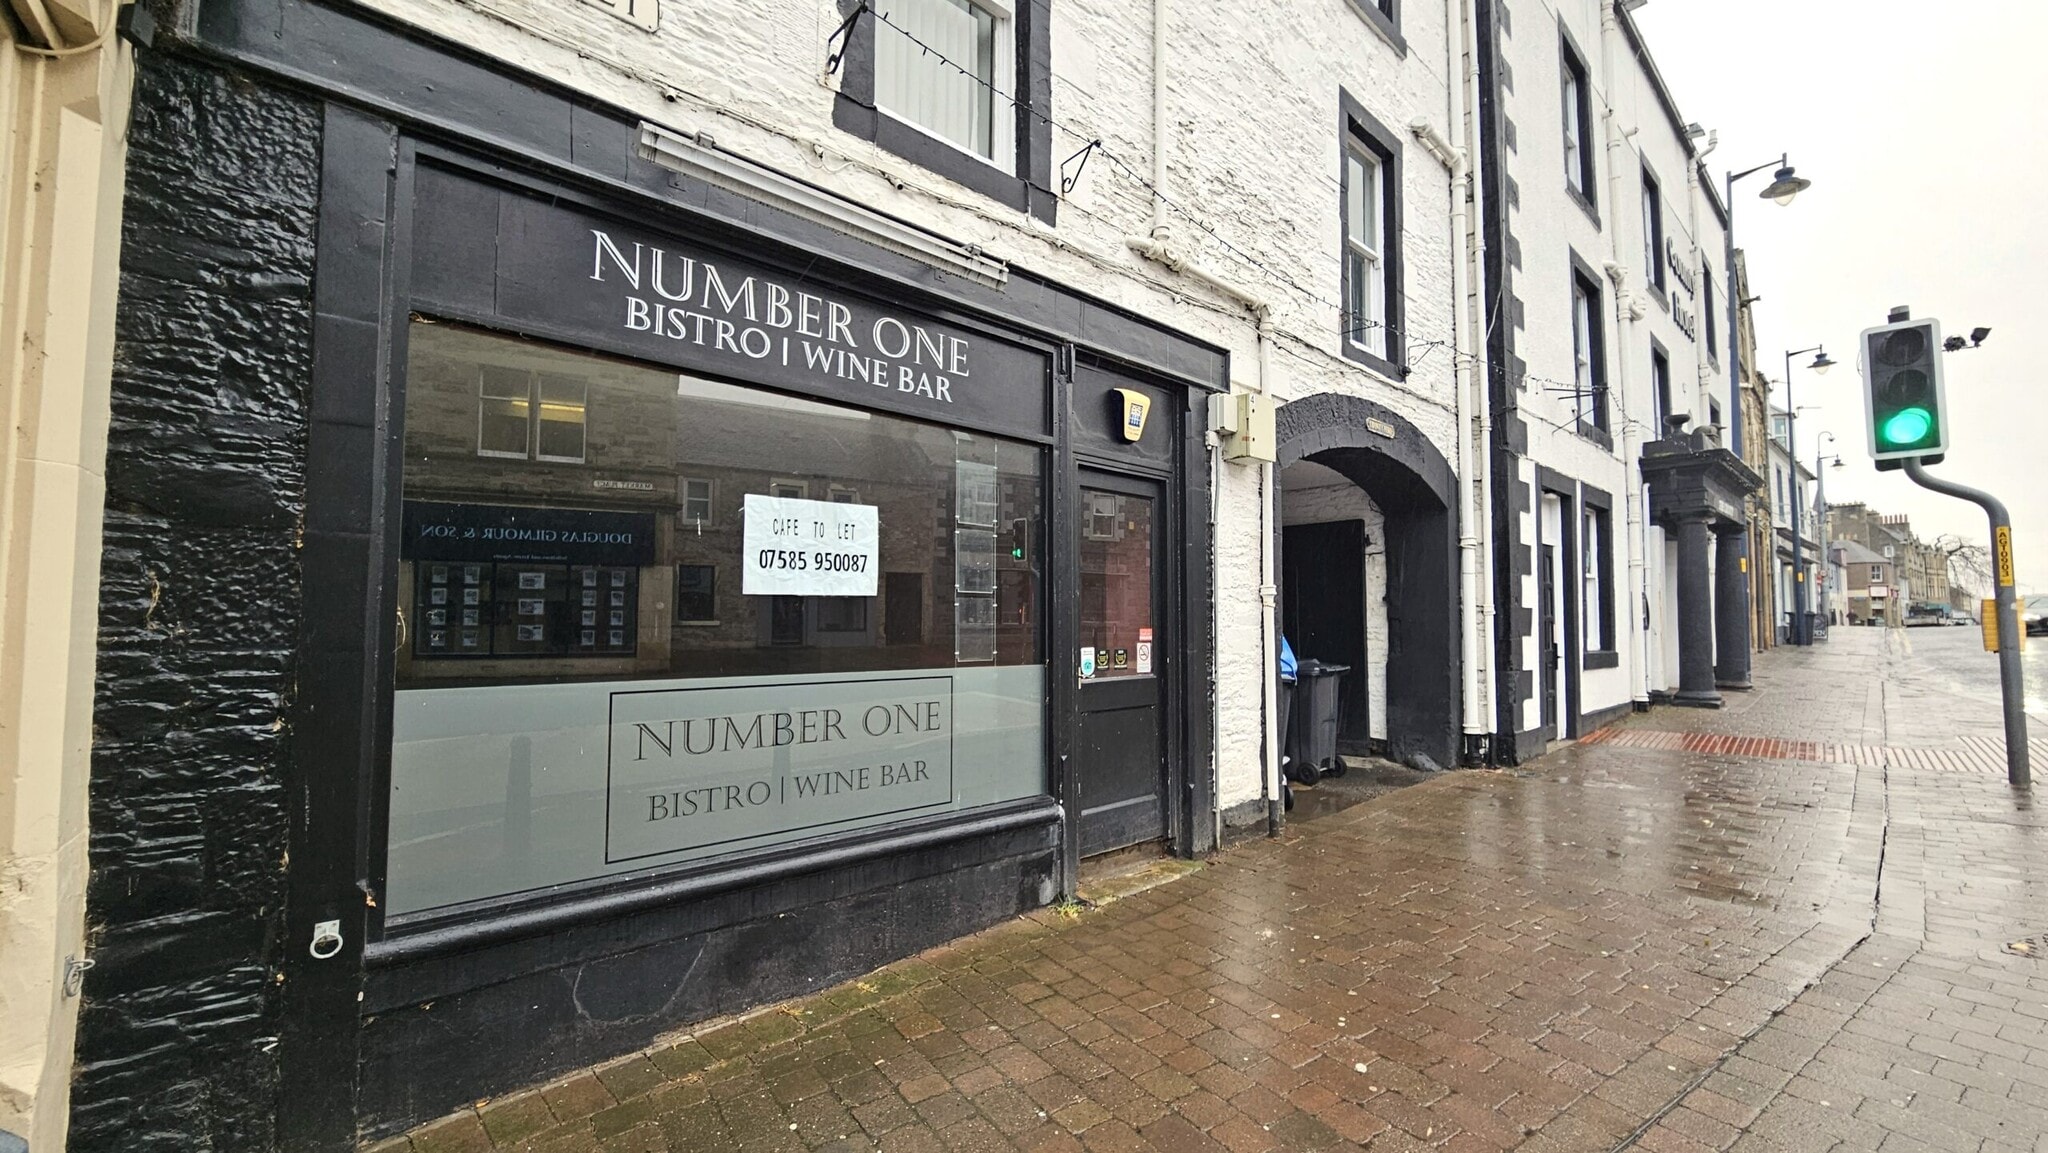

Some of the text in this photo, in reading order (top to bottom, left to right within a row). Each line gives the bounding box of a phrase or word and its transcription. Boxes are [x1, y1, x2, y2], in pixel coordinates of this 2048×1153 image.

[589, 229, 970, 378] NUMBER ONE
[624, 296, 772, 359] BISTRO
[802, 341, 889, 387] WINE
[897, 365, 953, 403] BAR
[773, 518, 855, 540] CAFE TO LET
[759, 549, 868, 573] 07585 950087
[633, 701, 941, 762] NUMBER ONE
[647, 781, 771, 822] BISTRO
[793, 767, 871, 798] WINE
[879, 760, 930, 787] BAR
